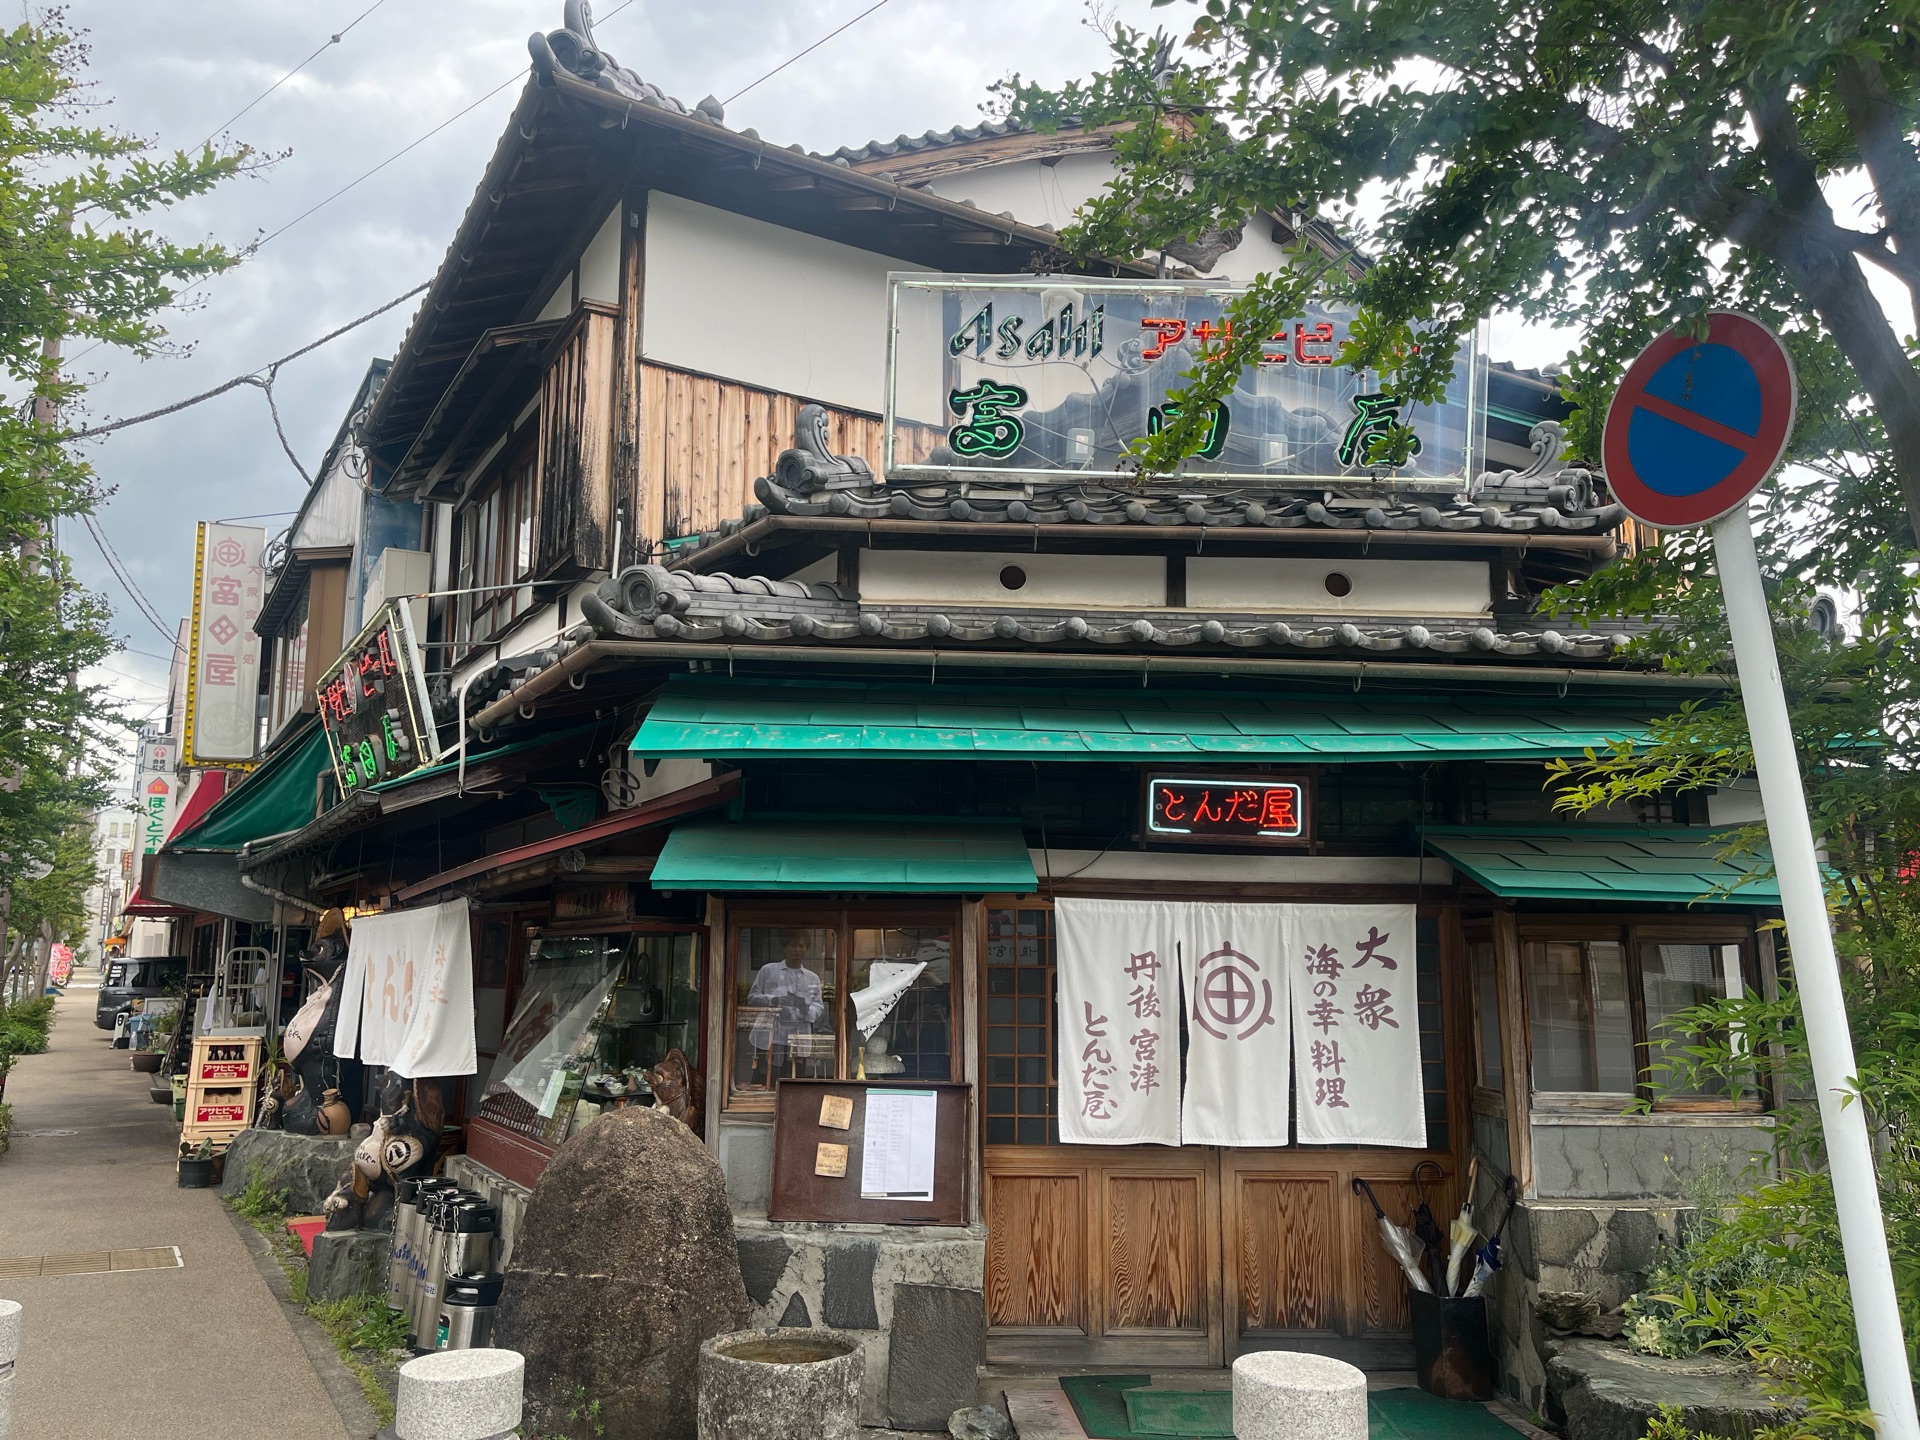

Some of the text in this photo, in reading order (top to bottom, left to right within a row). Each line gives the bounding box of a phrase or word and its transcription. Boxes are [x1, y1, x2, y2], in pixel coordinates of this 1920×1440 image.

[949, 301, 1104, 360] Asahi
[1161, 788, 1297, 828] とんだ屋
[1352, 926, 1399, 1031] 大衆
[1304, 943, 1350, 1109] 海の幸料理
[204, 1064, 248, 1073] アサヒビール
[1081, 1000, 1118, 1119] とんだ屋
[199, 1107, 242, 1115] アサヒビール
